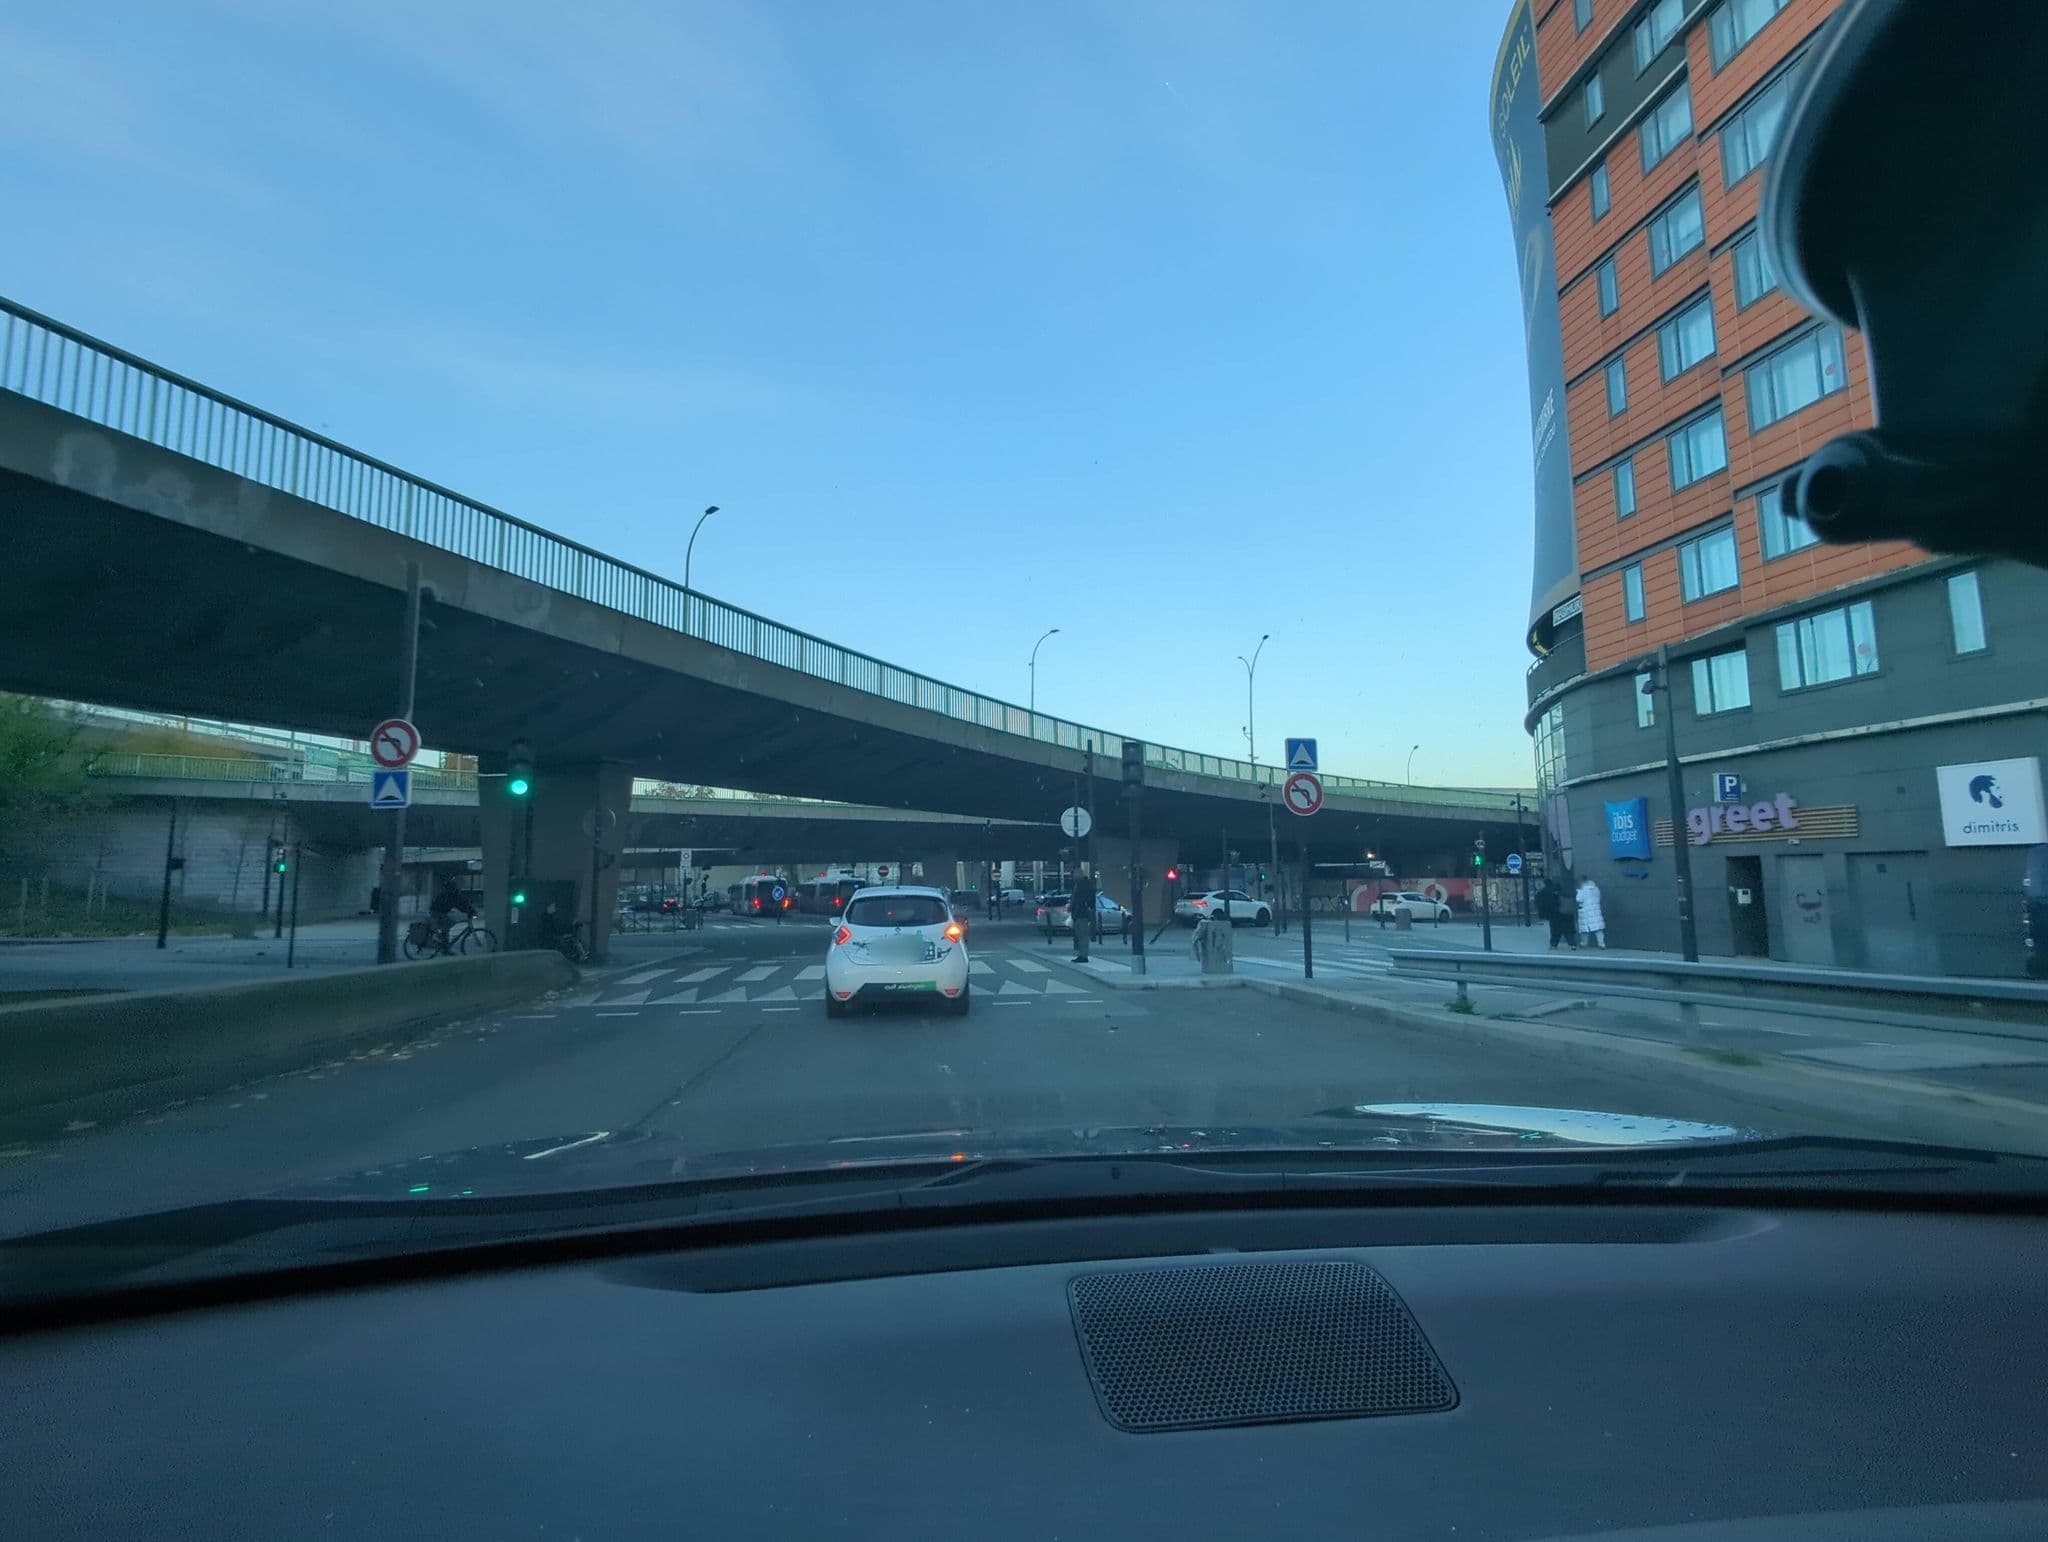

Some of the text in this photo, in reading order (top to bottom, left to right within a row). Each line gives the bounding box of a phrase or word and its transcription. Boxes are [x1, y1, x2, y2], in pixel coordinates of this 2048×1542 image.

[1725, 776, 1737, 792] P
[1613, 811, 1633, 829] ibis
[1687, 793, 1797, 845] greet
[1963, 820, 2019, 834] dimitris
